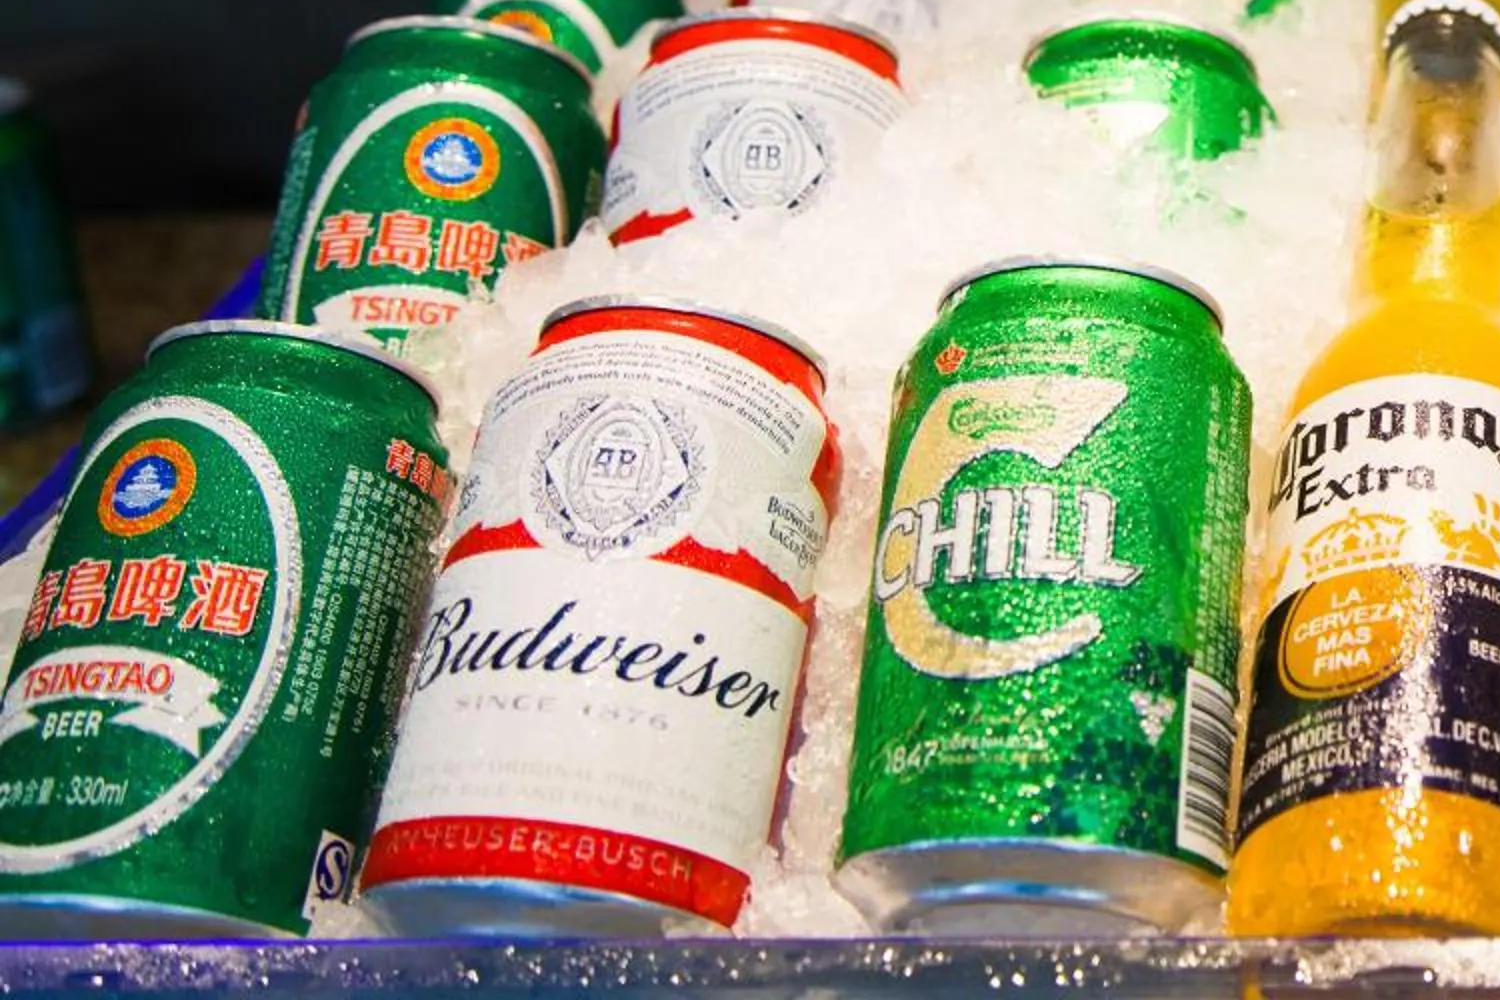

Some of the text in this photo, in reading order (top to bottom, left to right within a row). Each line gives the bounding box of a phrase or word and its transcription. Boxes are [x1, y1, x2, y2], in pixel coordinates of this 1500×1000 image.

[1295, 462, 1438, 522] Extra
[874, 486, 1145, 604] CHILL
[1331, 586, 1363, 609] LA
[1292, 600, 1404, 643] CERVEZA
[1316, 626, 1373, 655] MAS
[412, 597, 781, 719] Budweiser
[1313, 649, 1372, 677] FINA
[24, 661, 174, 698] TSINGTAO
[454, 693, 555, 712] SINCE
[41, 710, 103, 741] BEER
[65, 773, 129, 807] 330ml
